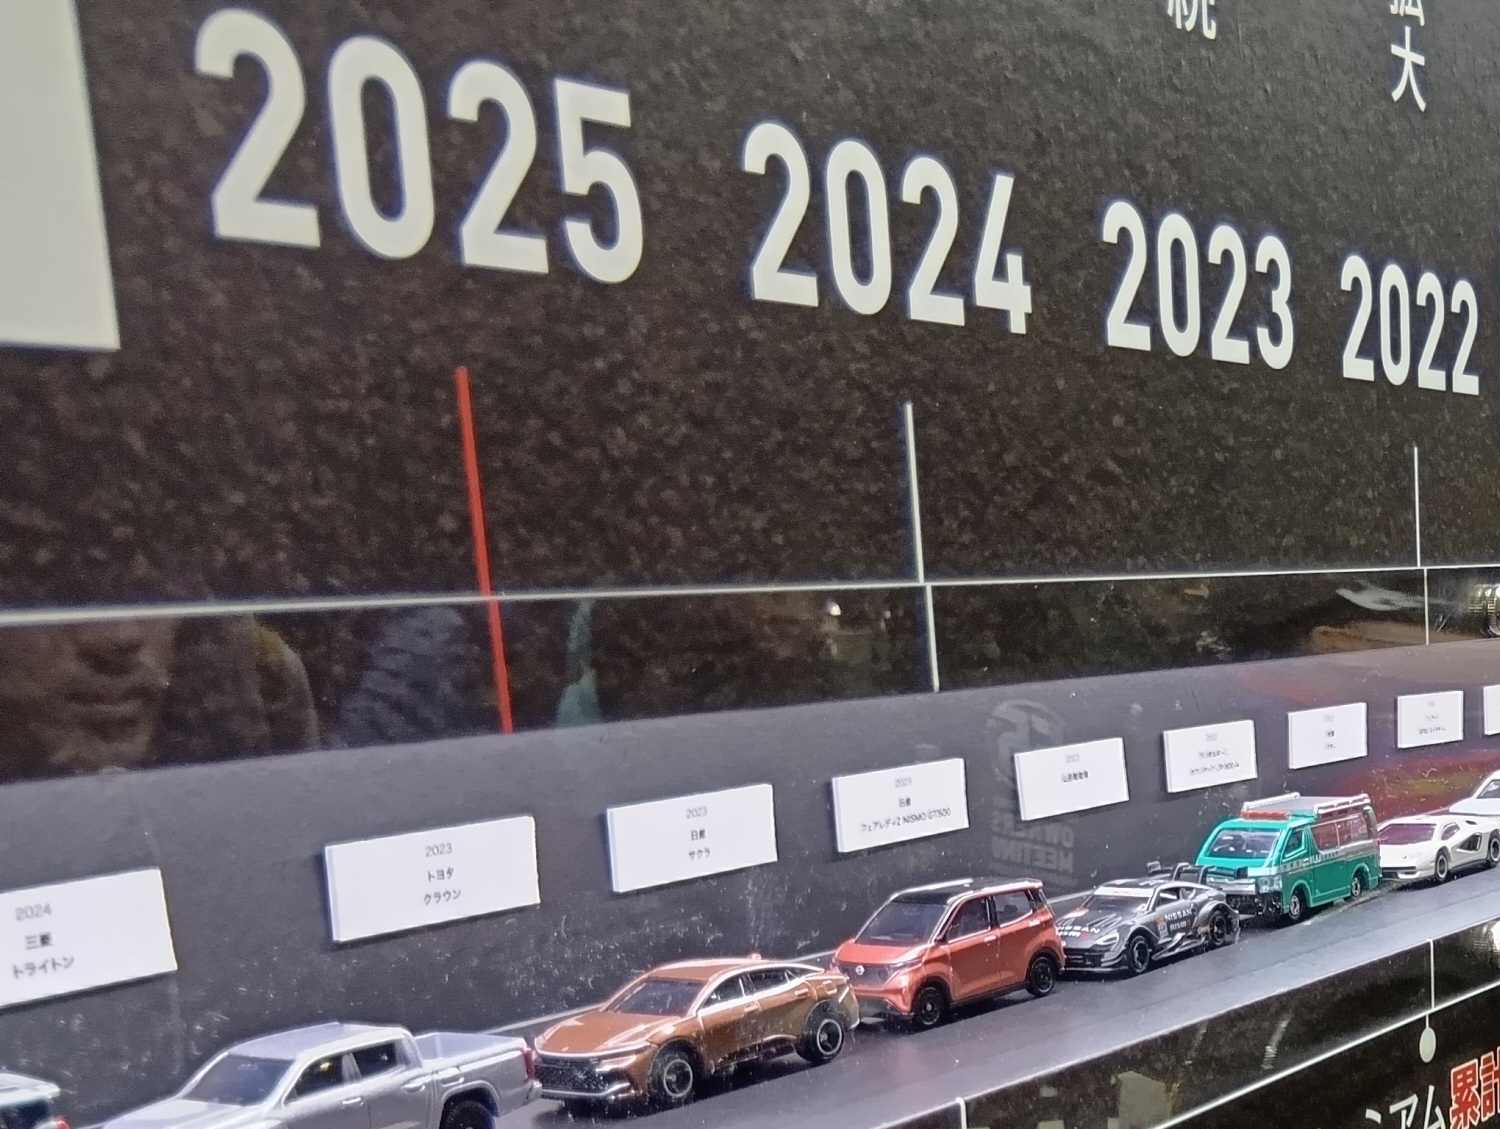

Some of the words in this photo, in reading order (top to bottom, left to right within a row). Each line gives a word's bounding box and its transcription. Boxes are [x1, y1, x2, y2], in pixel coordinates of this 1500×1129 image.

[194, 8, 644, 284] 2025
[742, 120, 1033, 335] 2024
[1101, 199, 1294, 370] 2023
[1340, 253, 1480, 396] 2022
[424, 841, 453, 858] 2023
[427, 866, 455, 882] トヨタ
[423, 888, 462, 906] クラウン
[14, 902, 53, 922] 2024
[12, 955, 76, 979] トライトン
